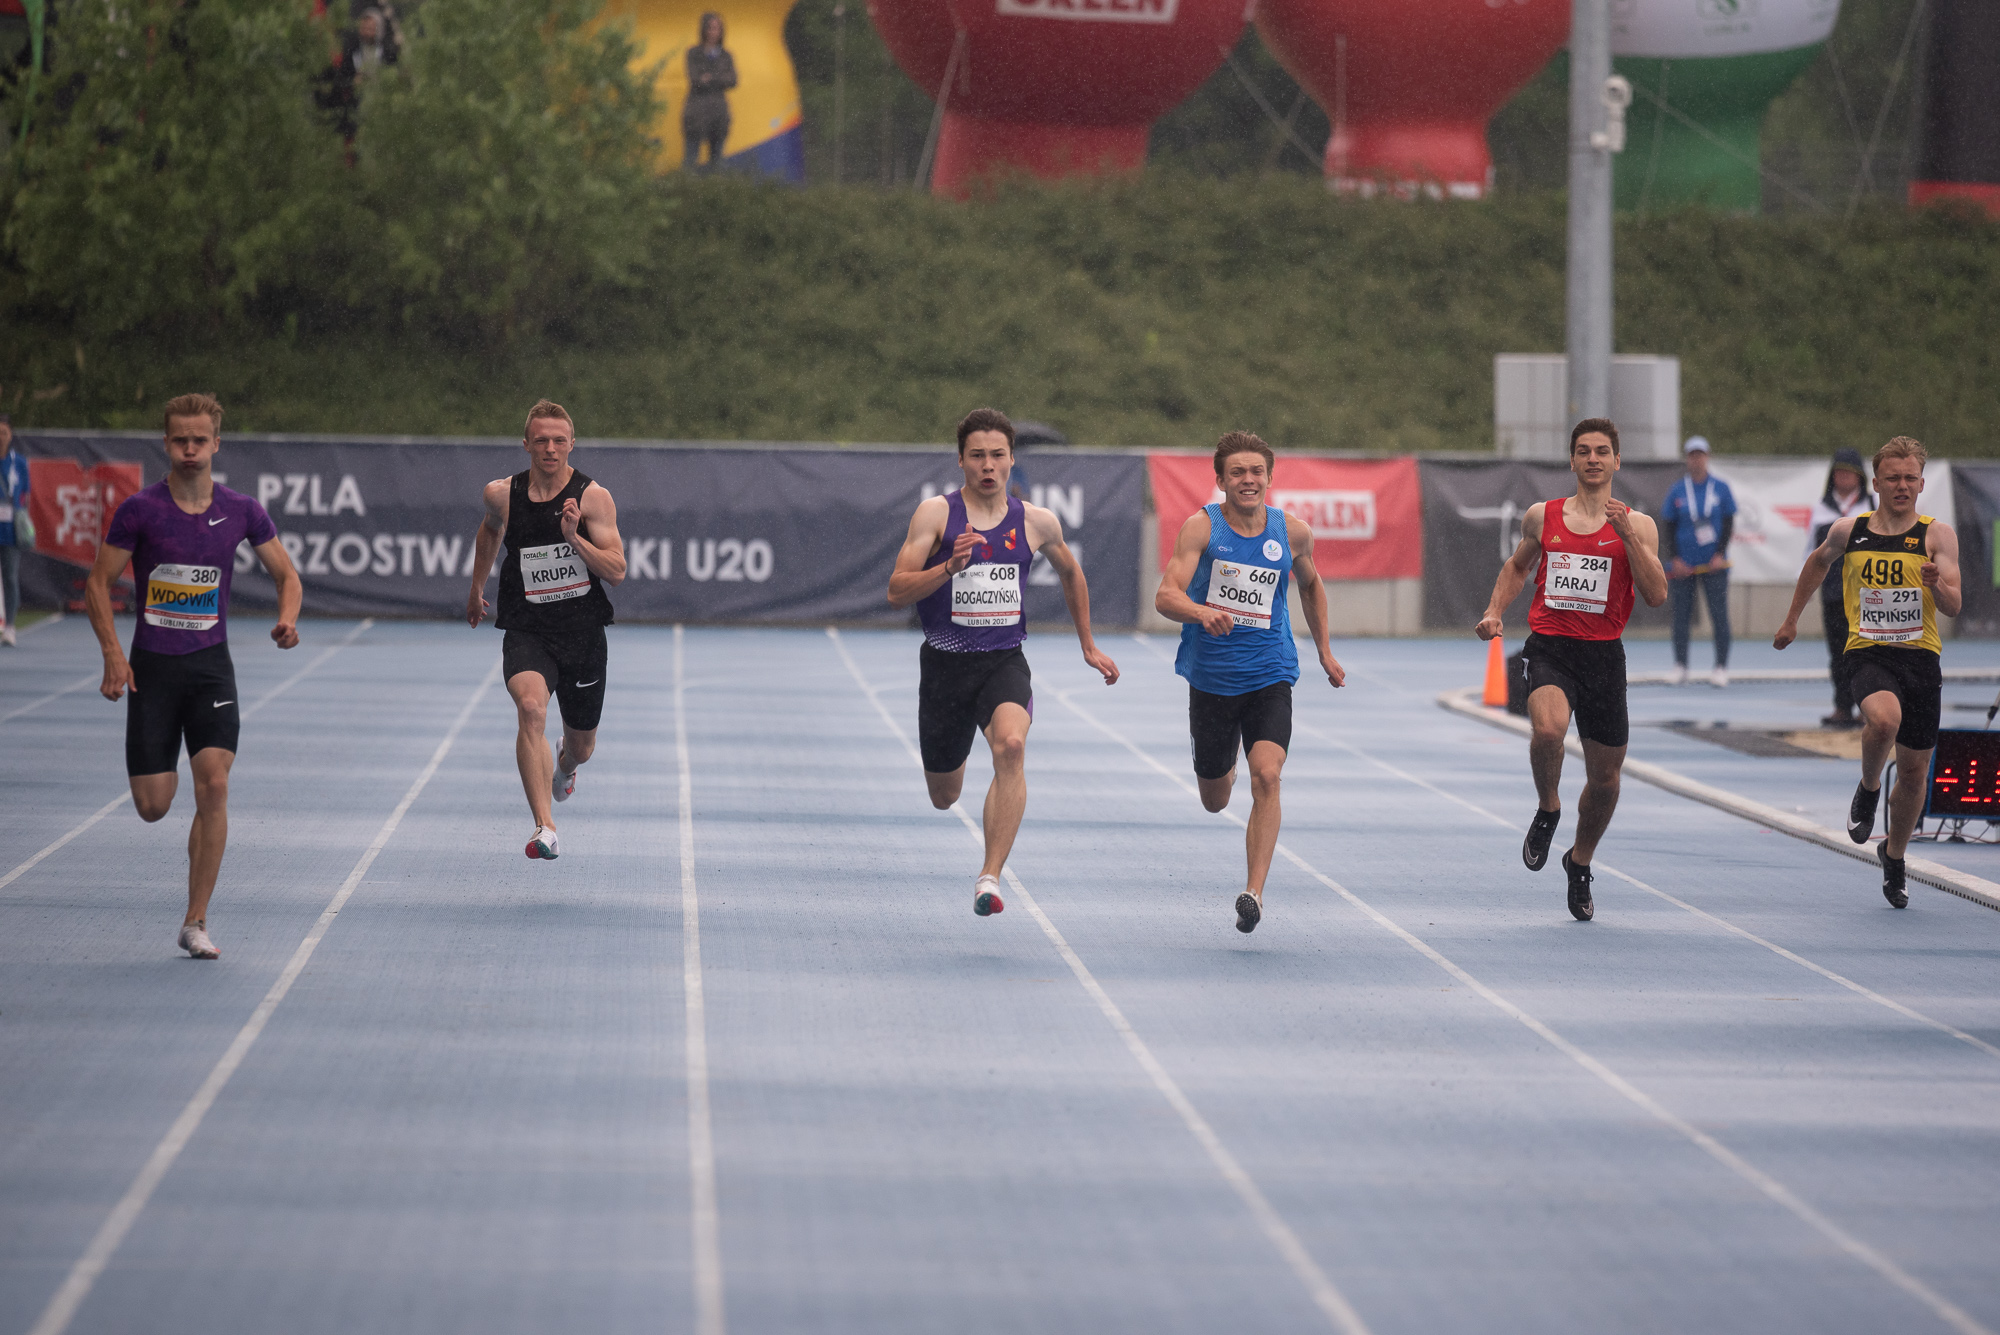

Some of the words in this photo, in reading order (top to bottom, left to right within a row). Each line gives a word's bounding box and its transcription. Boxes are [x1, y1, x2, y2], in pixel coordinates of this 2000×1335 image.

[257, 474, 365, 516] PZLA
[685, 537, 775, 583] U20
[1580, 557, 1608, 572] 284
[191, 569, 218, 583] 380
[531, 565, 578, 584] KRUPA
[989, 567, 1015, 581] 608
[1249, 569, 1276, 585] 660
[1861, 558, 1903, 586] 498
[1554, 575, 1597, 593] FARAJ
[151, 587, 216, 608] WDOWIK
[539, 594, 561, 603] LUBLIN
[562, 591, 578, 599] 2021
[955, 587, 1019, 605] BOGACZYŃSKI
[1218, 585, 1264, 606] SOBÓL
[1892, 590, 1919, 603] 291
[1554, 601, 1575, 609] LUBLIN
[1576, 603, 1592, 611] 2021
[159, 618, 184, 628] LUBLIN
[186, 621, 203, 630] 2021
[1241, 616, 1257, 626] 2021
[1862, 608, 1921, 625] KĘPIŃSKI
